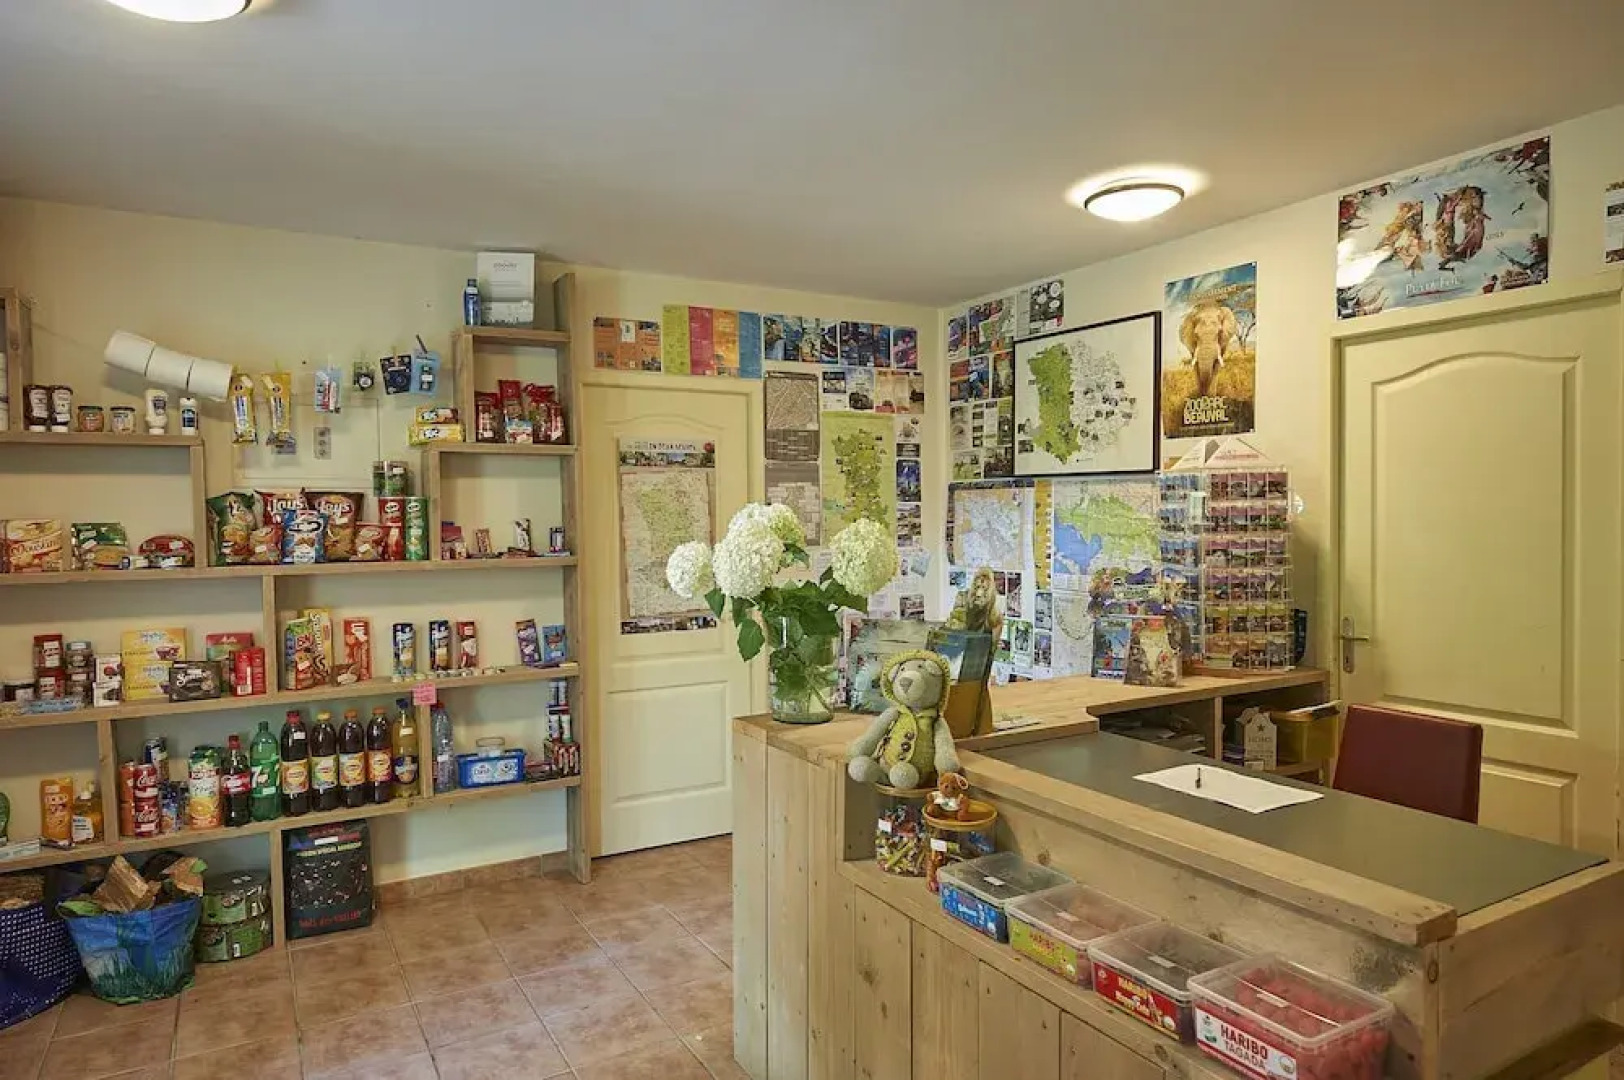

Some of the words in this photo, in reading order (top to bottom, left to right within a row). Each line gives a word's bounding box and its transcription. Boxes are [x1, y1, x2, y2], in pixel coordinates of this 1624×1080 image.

[1183, 408, 1228, 424] BEAUVAL
[1220, 1023, 1268, 1060] HARIBO
[1225, 1040, 1266, 1071] TAGADA
